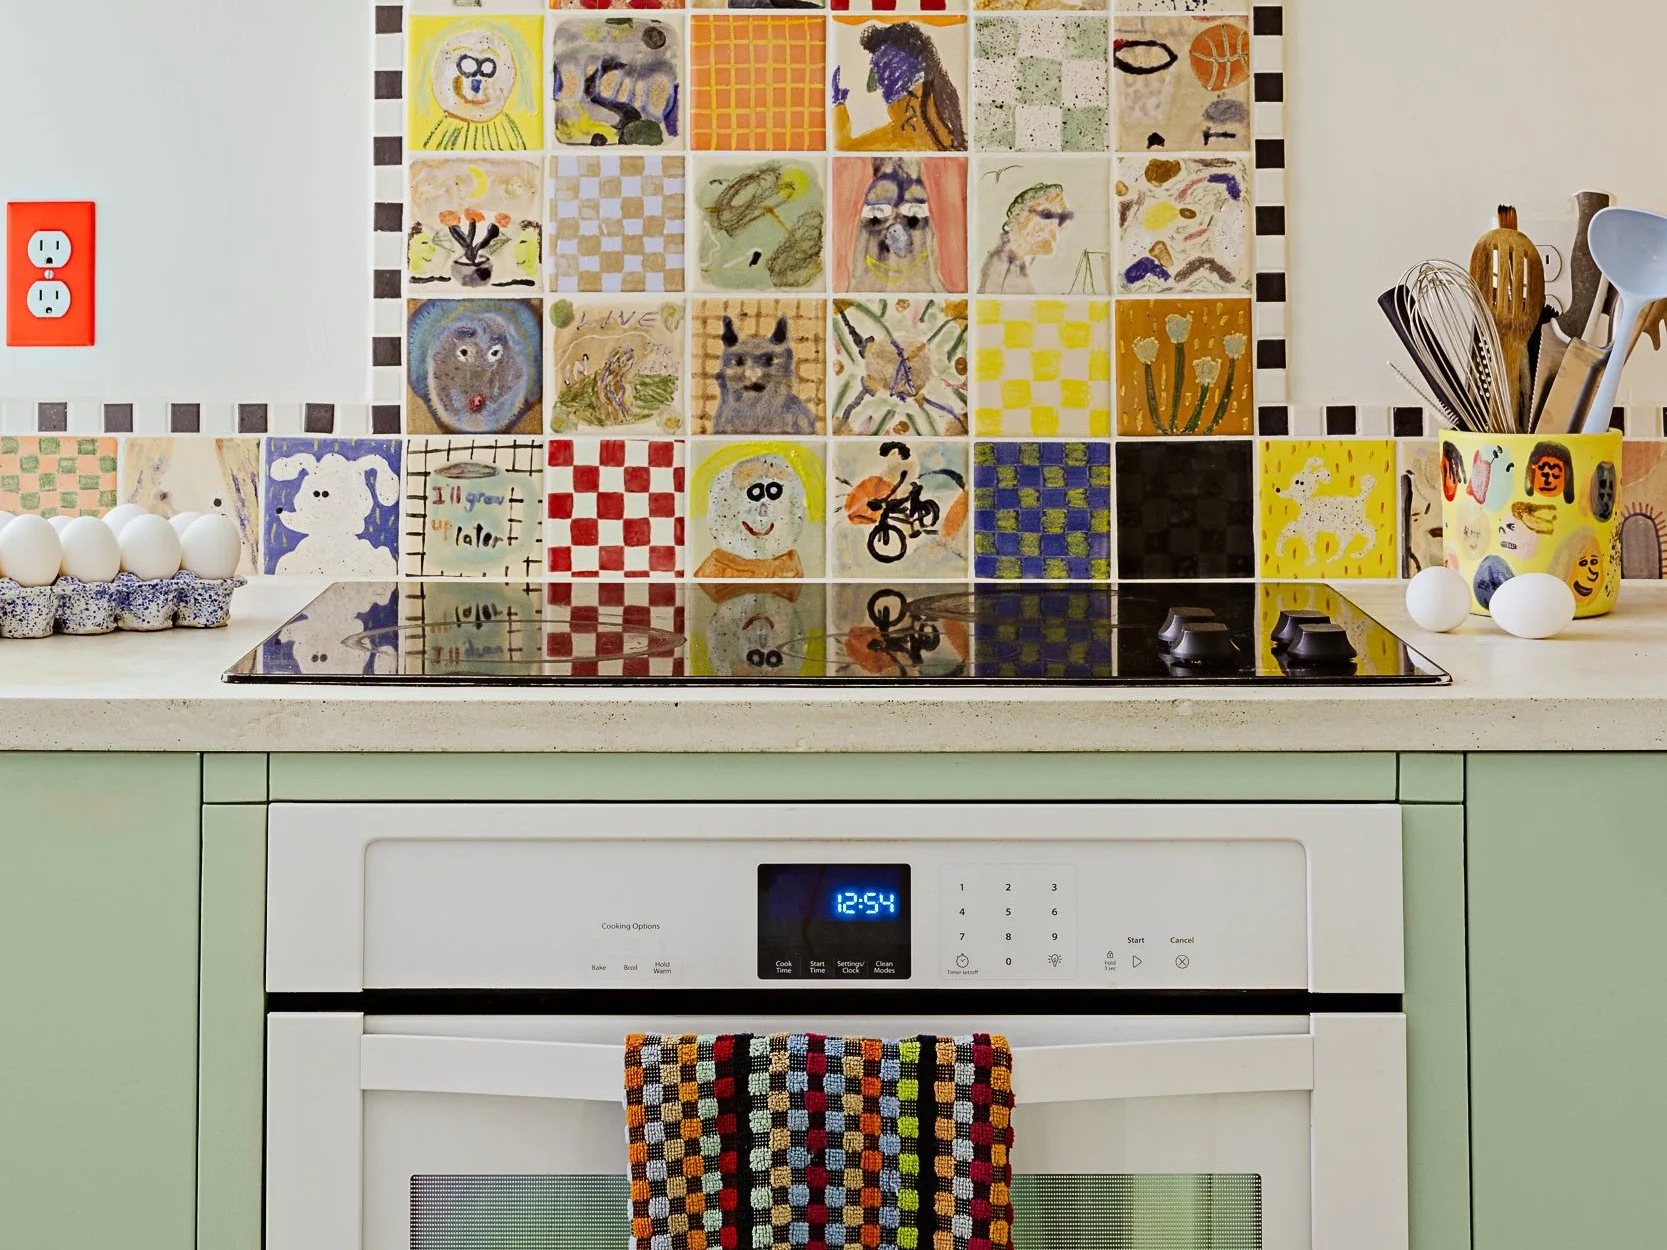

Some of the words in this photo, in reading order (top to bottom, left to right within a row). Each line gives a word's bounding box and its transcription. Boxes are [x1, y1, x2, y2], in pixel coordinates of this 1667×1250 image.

[576, 310, 659, 330] LIVE
[464, 492, 505, 513] grow
[430, 519, 453, 541] up
[455, 523, 504, 549] later
[960, 883, 964, 891] 1
[1005, 883, 1011, 891] 2
[1051, 883, 1058, 891] 3
[837, 892, 895, 914] 12:54
[959, 908, 965, 916] 4
[1005, 907, 1012, 916] 5
[1051, 907, 1058, 916] 6
[601, 923, 631, 931] Cooking
[632, 923, 660, 931] Options
[959, 932, 965, 941] 7
[1005, 932, 1012, 941] 8
[1051, 932, 1058, 941] 9
[1127, 936, 1145, 944] Start
[1170, 936, 1195, 944] Cancel
[837, 960, 865, 969] Settings/
[1005, 957, 1012, 966] 0
